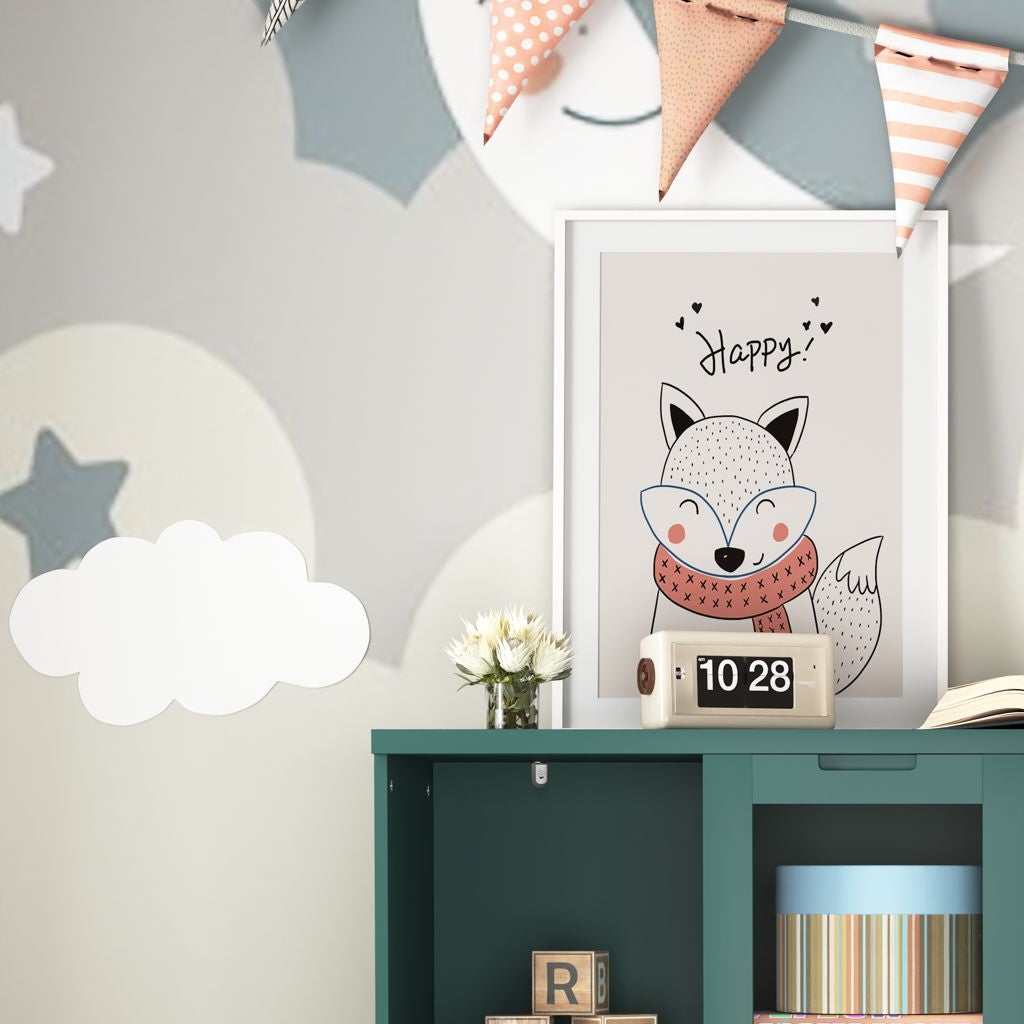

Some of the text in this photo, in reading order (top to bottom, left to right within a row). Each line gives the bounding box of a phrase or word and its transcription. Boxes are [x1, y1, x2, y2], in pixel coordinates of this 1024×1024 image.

[695, 329, 814, 375] Happy!
[699, 659, 791, 693] 10 28
[546, 962, 579, 1005] R
[597, 962, 606, 1004] B
